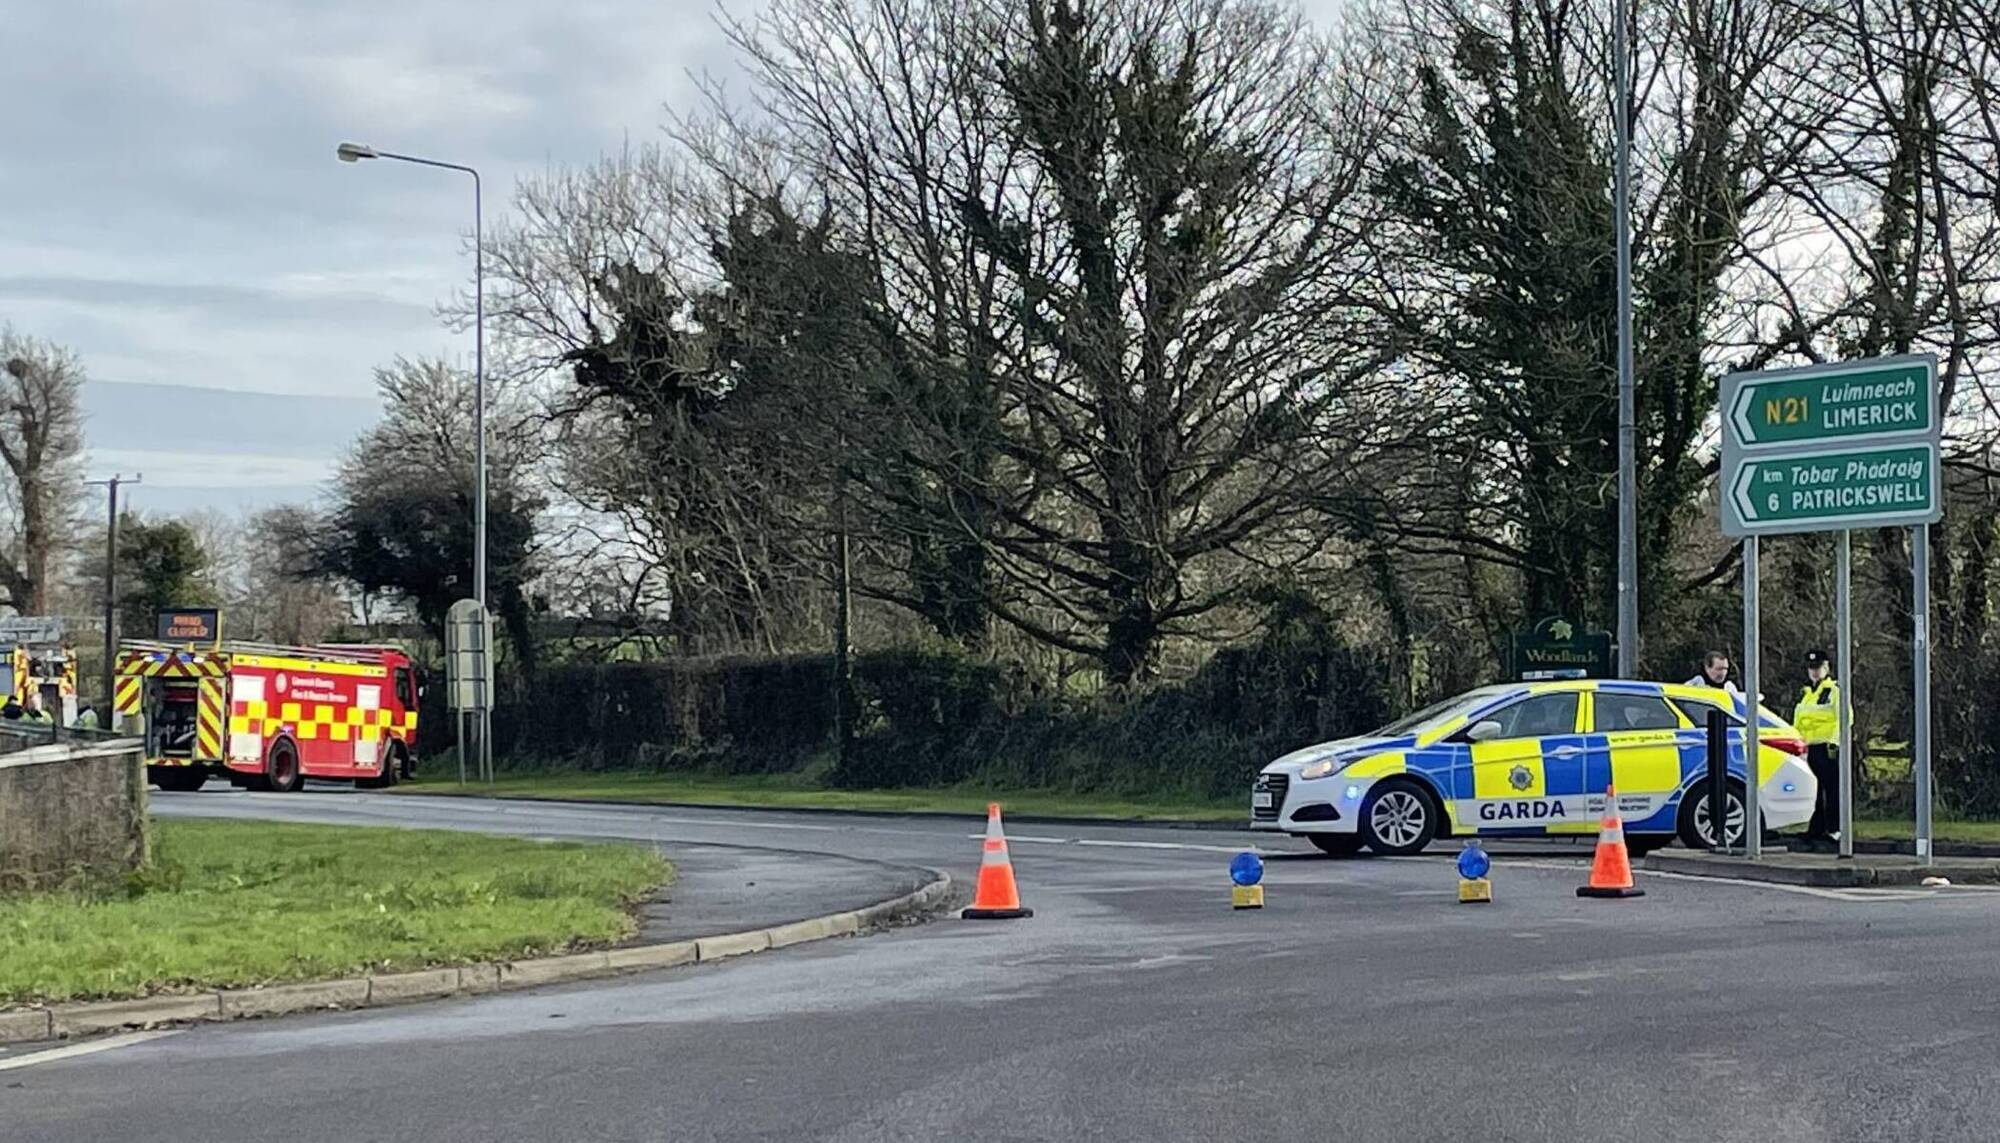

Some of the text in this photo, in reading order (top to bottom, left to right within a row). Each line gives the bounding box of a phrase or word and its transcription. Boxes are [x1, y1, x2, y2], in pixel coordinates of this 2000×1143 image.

[1821, 377, 1916, 404] Luimneach
[1766, 396, 1809, 425] N21
[1823, 402, 1917, 429] LIMERICK
[1763, 469, 1783, 483] km
[1791, 466, 1839, 486] Tobar
[1768, 482, 1925, 512] 6 PATRICKSWELL
[1525, 649, 1600, 663] Woodlands
[1480, 800, 1566, 820] GARDA
